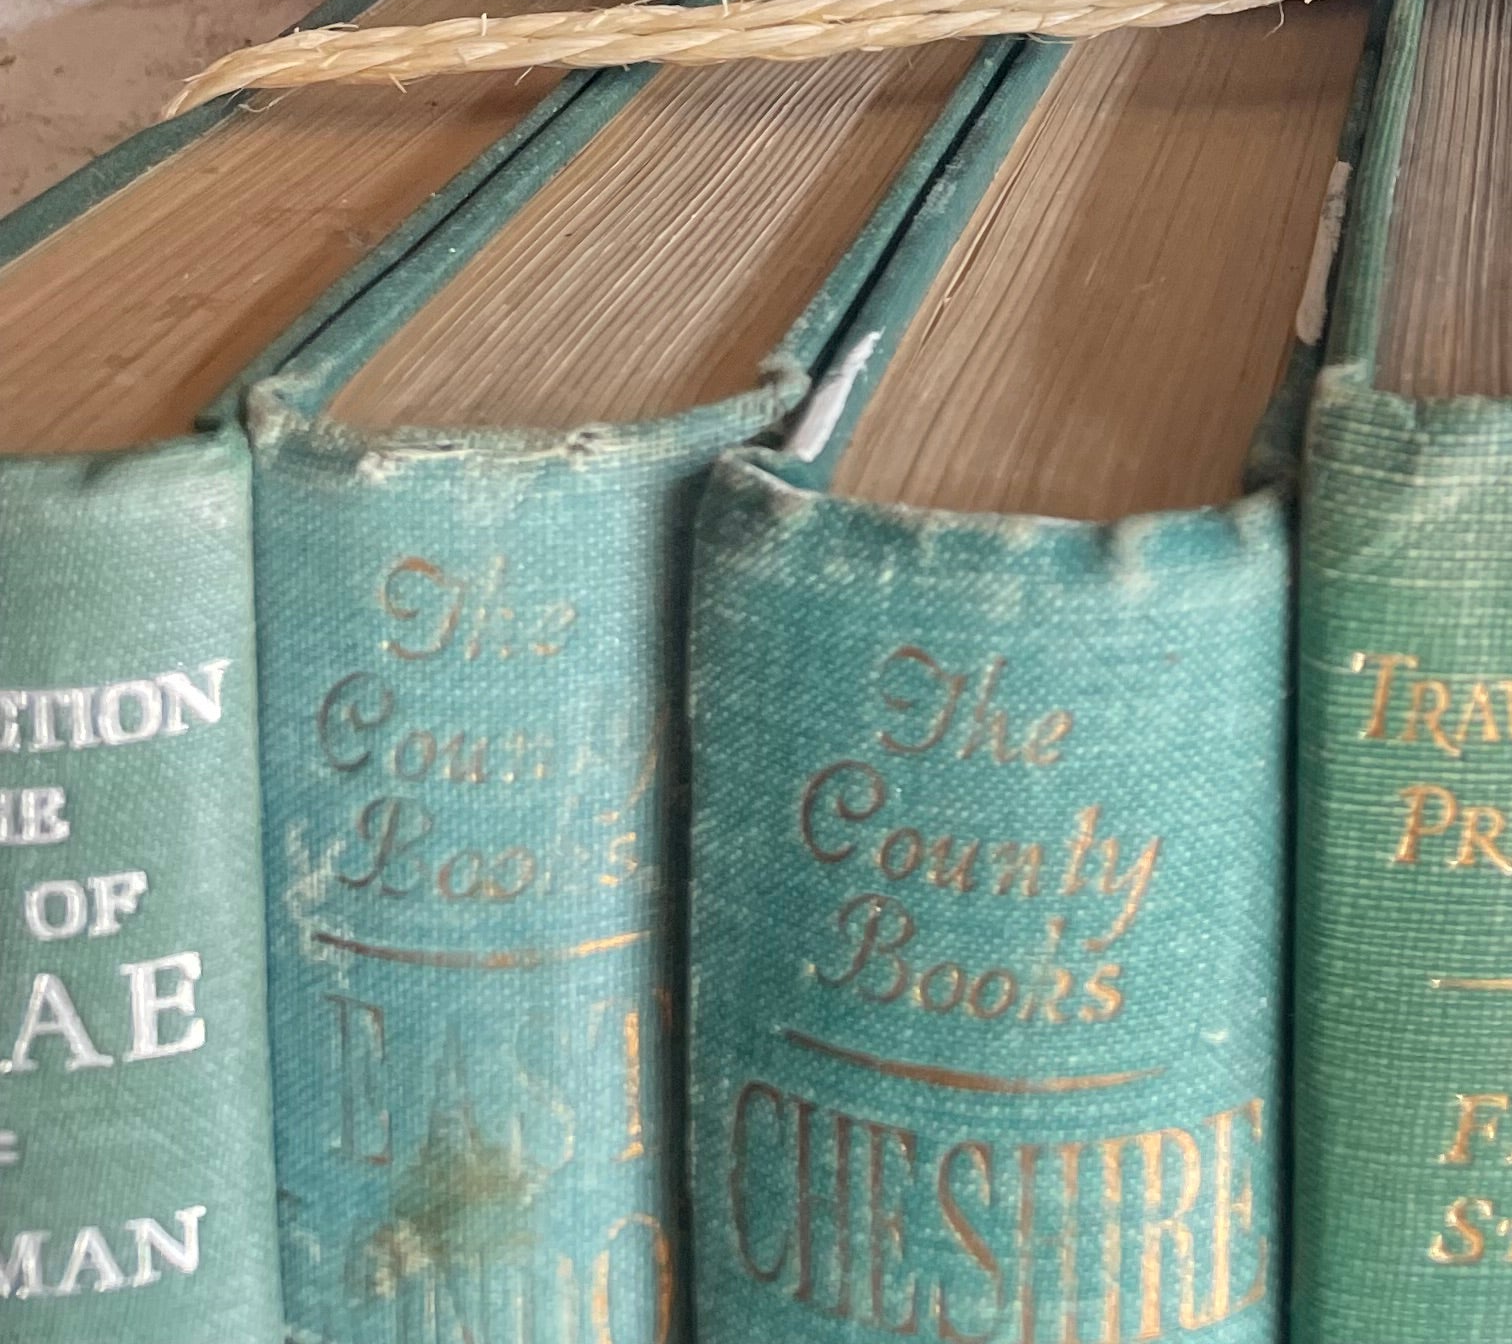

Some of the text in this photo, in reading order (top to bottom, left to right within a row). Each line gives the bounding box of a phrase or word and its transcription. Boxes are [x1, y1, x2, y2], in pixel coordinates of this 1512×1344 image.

[379, 555, 577, 660] The
[877, 645, 1074, 765] The
[24, 870, 149, 941] OF
[801, 759, 1164, 952] County
[0, 950, 207, 1075] AE
[806, 895, 1129, 1024] Books
[730, 1080, 1270, 1344] CHESHIRE
